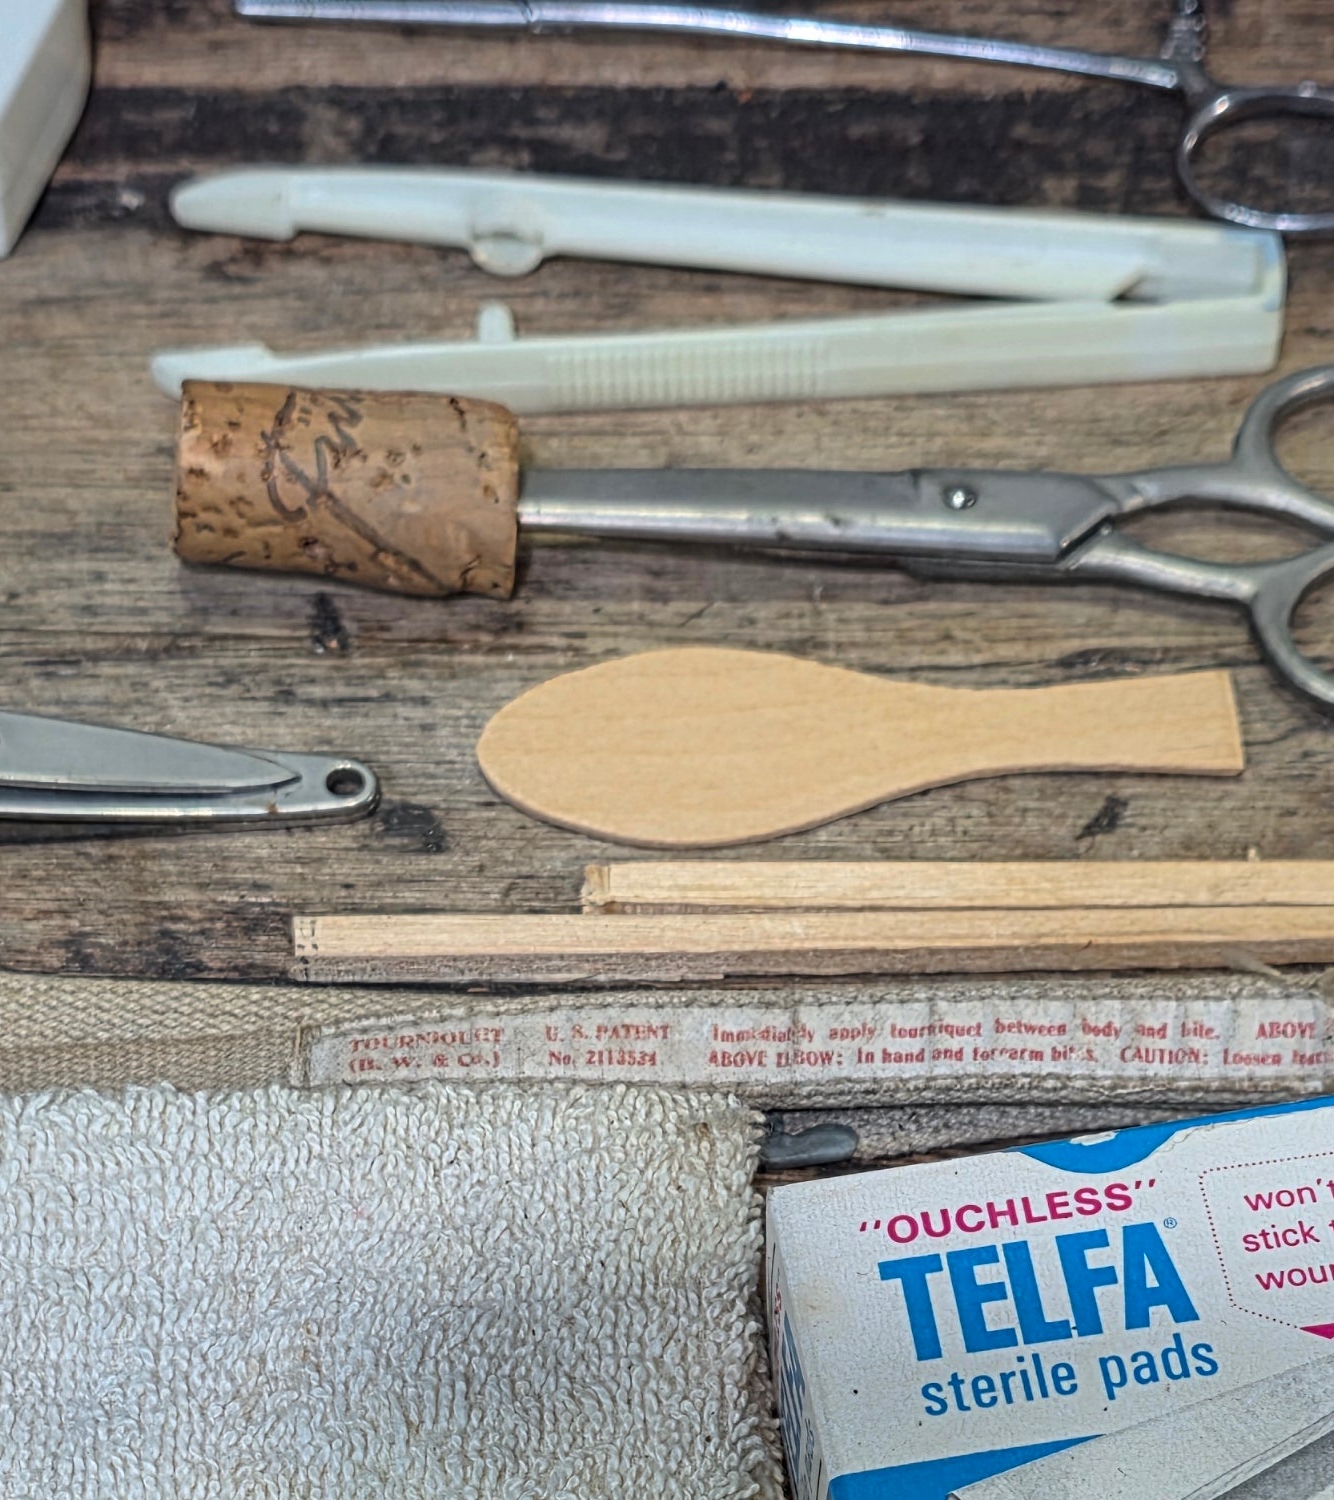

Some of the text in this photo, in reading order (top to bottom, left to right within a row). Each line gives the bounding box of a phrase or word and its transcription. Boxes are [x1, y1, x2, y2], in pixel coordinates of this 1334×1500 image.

[350, 1027, 504, 1052] TOURNIQUET
[546, 1025, 564, 1042] U.
[572, 1024, 588, 1040] S.
[596, 1024, 671, 1041] PATENT
[829, 1023, 875, 1041] apply
[890, 1021, 982, 1039] tourniquet
[995, 1018, 1067, 1037] between
[1082, 1018, 1120, 1040] body
[1136, 1021, 1167, 1039] and
[1181, 1022, 1219, 1040] bite.
[392, 1056, 421, 1069] W.
[434, 1055, 448, 1068] &
[548, 1051, 575, 1066] No.
[709, 1051, 766, 1068] ABOVE
[881, 1048, 925, 1063] hand
[931, 1048, 963, 1062] and
[1120, 1048, 1208, 1065] CAUTION:
[1223, 1048, 1281, 1067] Loosen
[858, 1178, 1158, 1247] "OUCHLESS"
[1242, 1221, 1320, 1255] stick
[921, 1336, 1220, 1418] sterile pads
